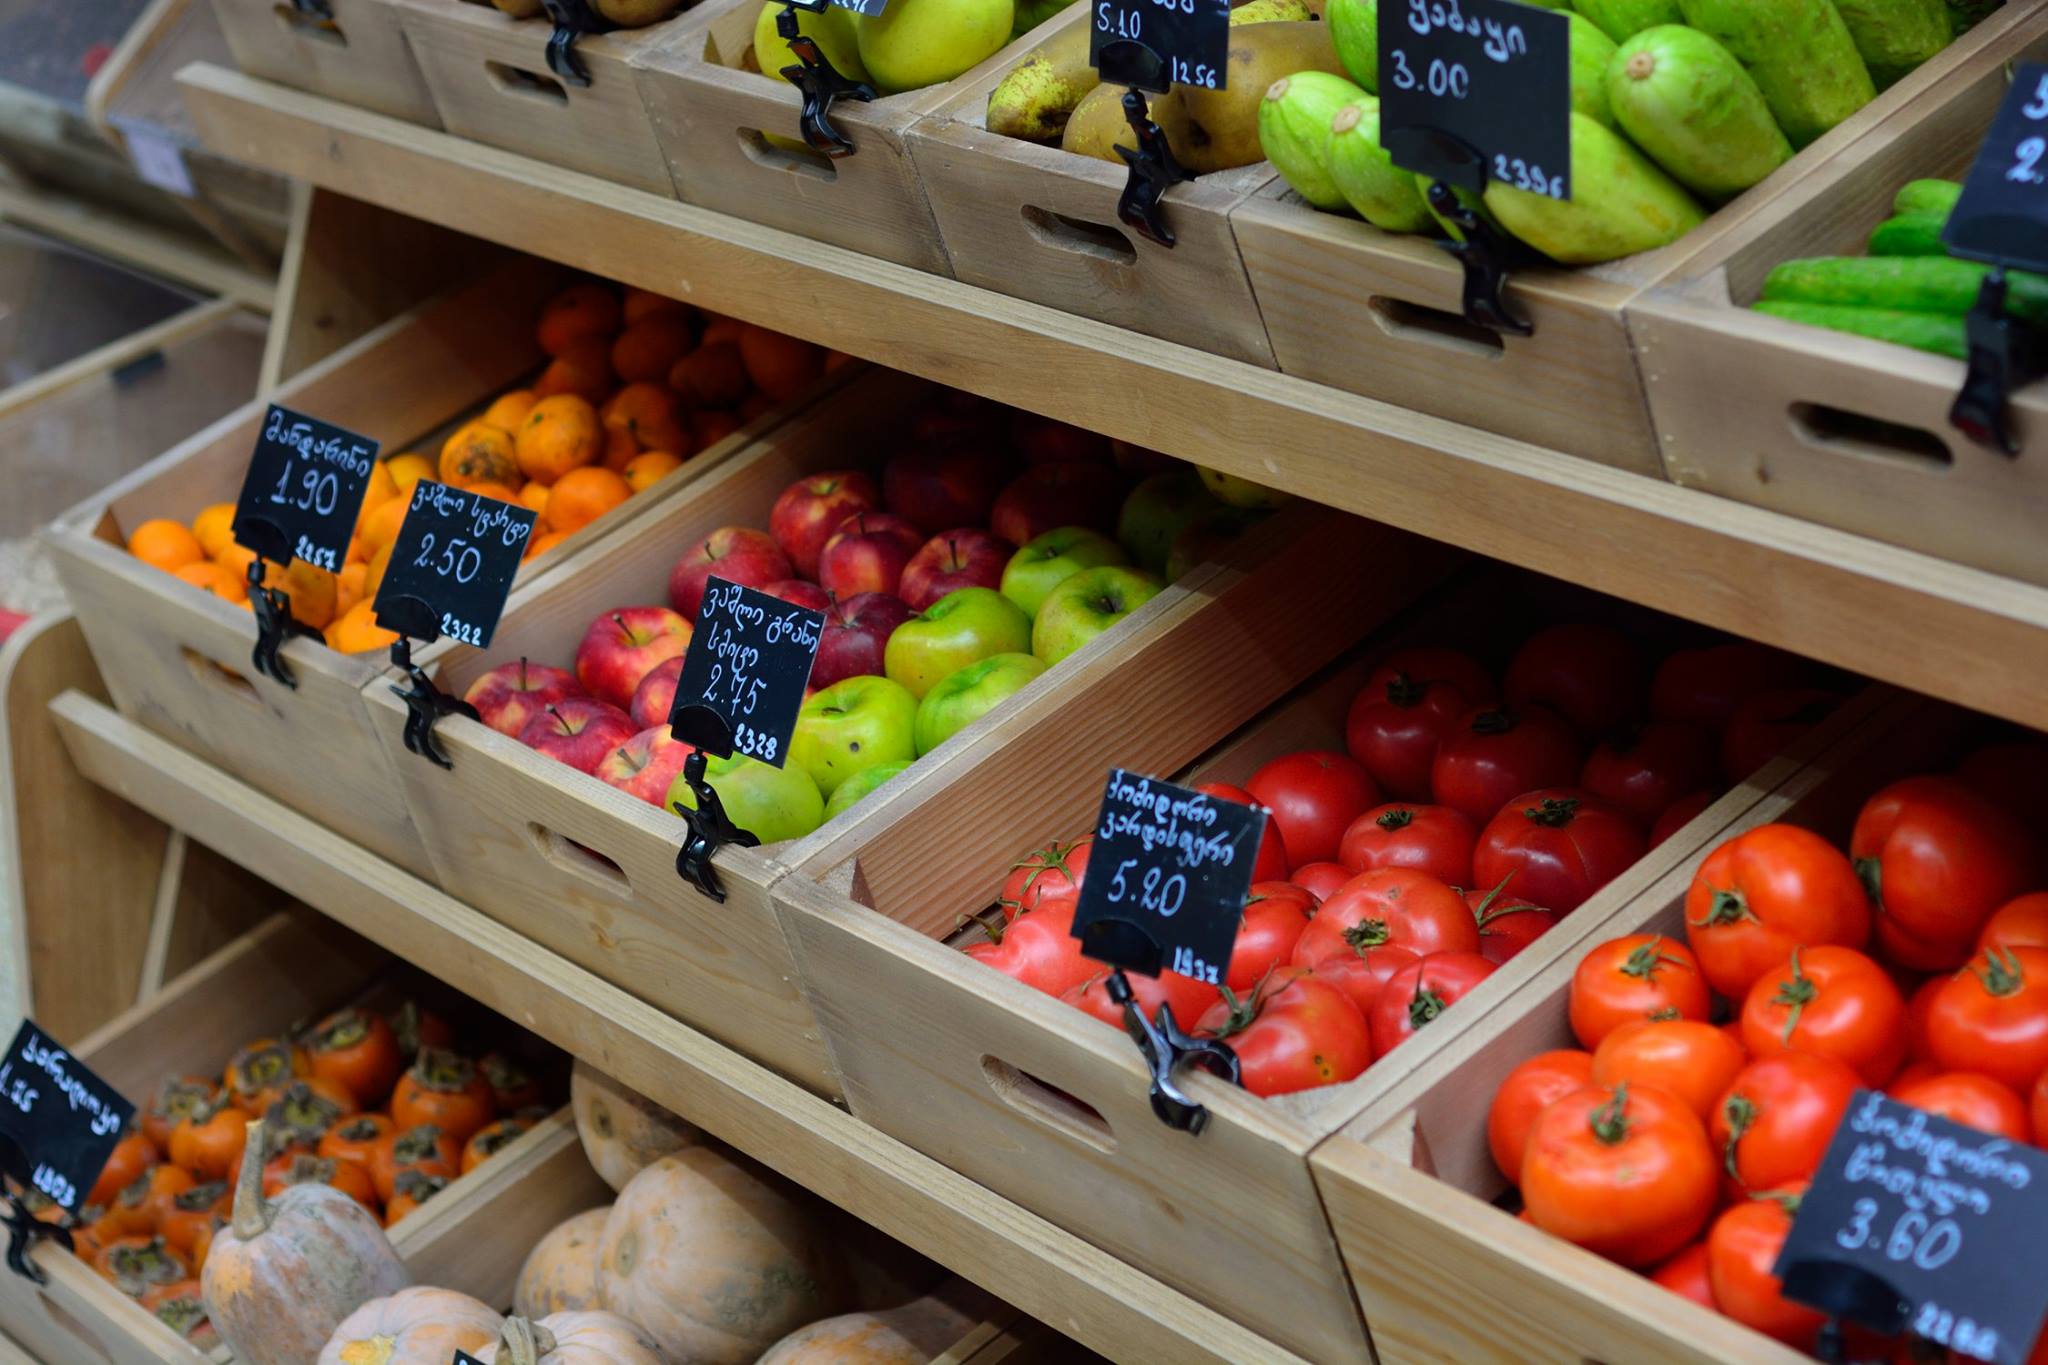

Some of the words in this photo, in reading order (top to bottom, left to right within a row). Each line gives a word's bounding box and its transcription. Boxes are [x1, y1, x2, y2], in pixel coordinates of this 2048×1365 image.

[1097, 2, 1140, 39] 5.10
[1172, 56, 1216, 89] 1256
[1391, 49, 1469, 99] 3.00
[266, 409, 370, 477] მანდარინი
[271, 459, 338, 516] 1.90
[411, 484, 465, 517] ვაშლი
[295, 535, 336, 573] 2257
[413, 533, 481, 583] 2.50
[441, 612, 482, 646] 2322
[703, 585, 765, 632] ვაშლი
[707, 621, 759, 673] სმიტი
[702, 664, 767, 717] 2.75
[734, 723, 778, 761] 2328
[1106, 768, 1217, 827] პომიდორი
[1100, 810, 1235, 867] ვარდისფერი
[1107, 859, 1187, 917] 5.20
[1851, 1090, 2032, 1190] პომიდორი
[1836, 1197, 1963, 1270] 3.60
